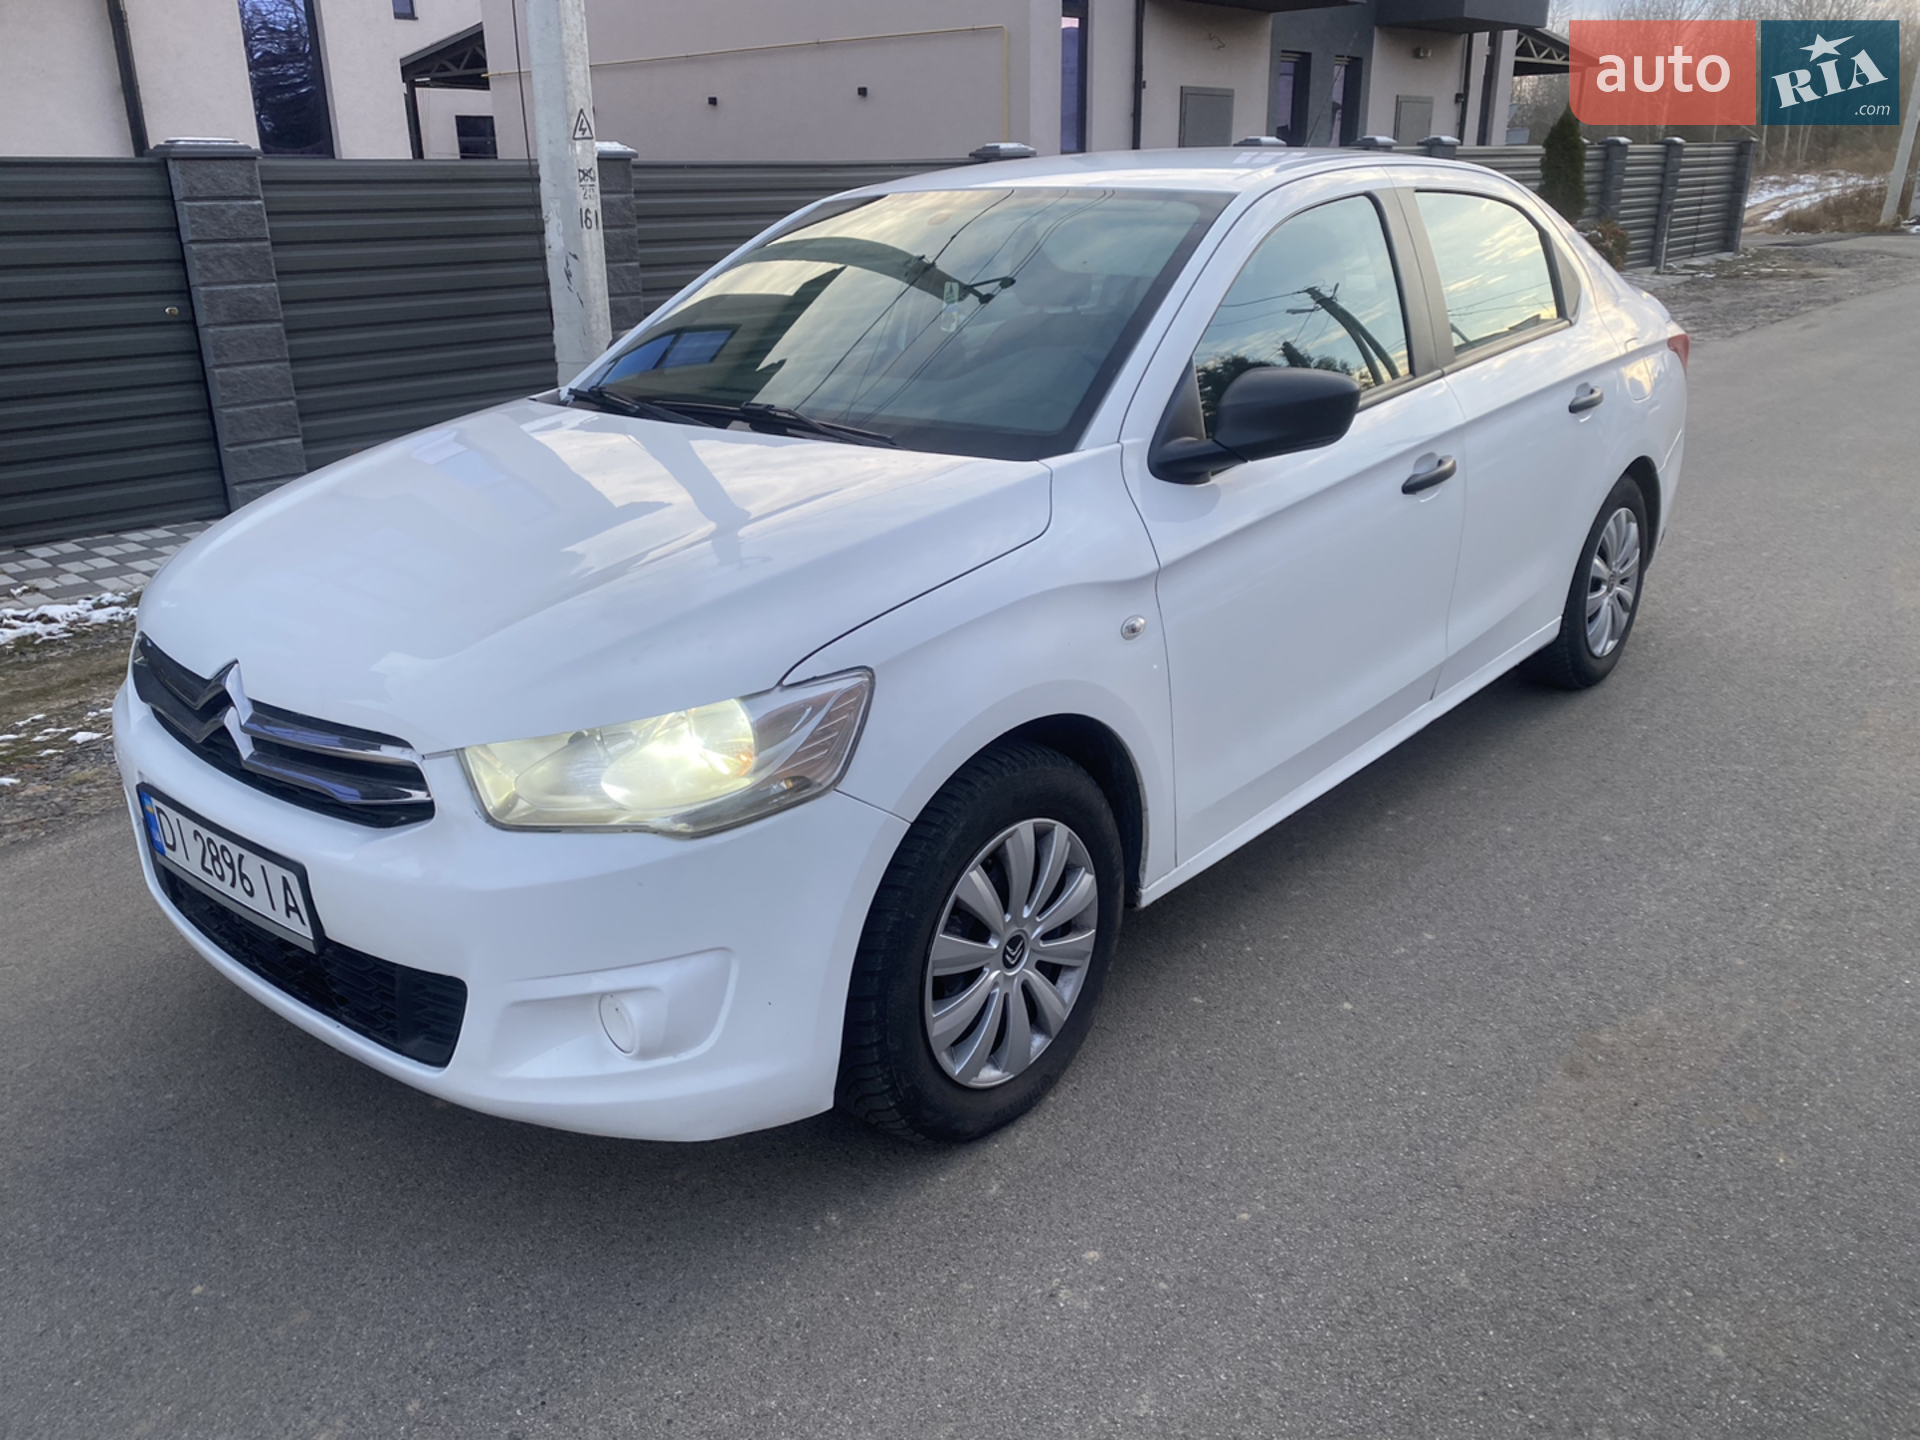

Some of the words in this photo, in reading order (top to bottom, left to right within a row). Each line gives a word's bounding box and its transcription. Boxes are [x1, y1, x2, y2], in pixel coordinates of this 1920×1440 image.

[579, 207, 599, 230] 161
[155, 805, 190, 861] DI
[193, 829, 255, 898] 2896
[261, 864, 306, 926] IA
